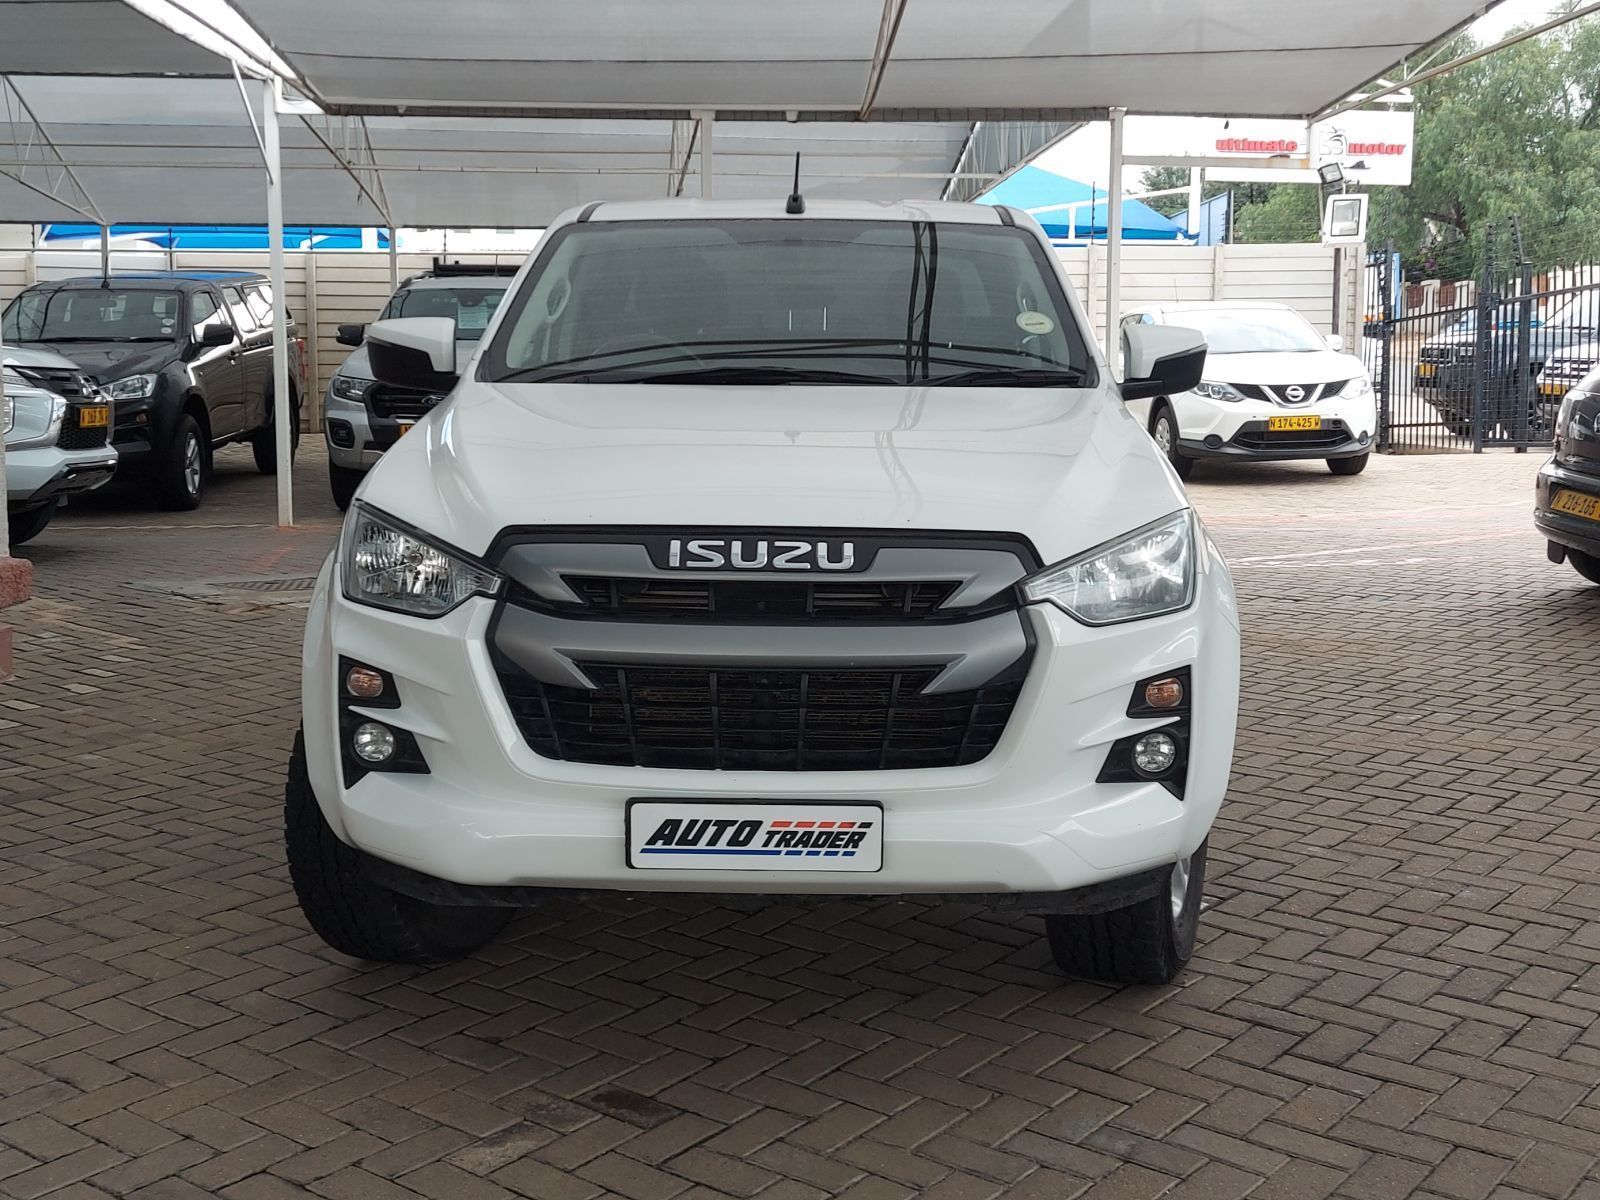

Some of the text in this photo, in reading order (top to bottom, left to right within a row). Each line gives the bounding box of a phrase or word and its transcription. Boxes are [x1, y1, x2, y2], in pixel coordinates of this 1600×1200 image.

[1216, 138, 1406, 155] ultimate motor
[1278, 417, 1312, 429] 174-425
[669, 540, 854, 569] ISUZU
[644, 819, 867, 848] AUTO TRADER
